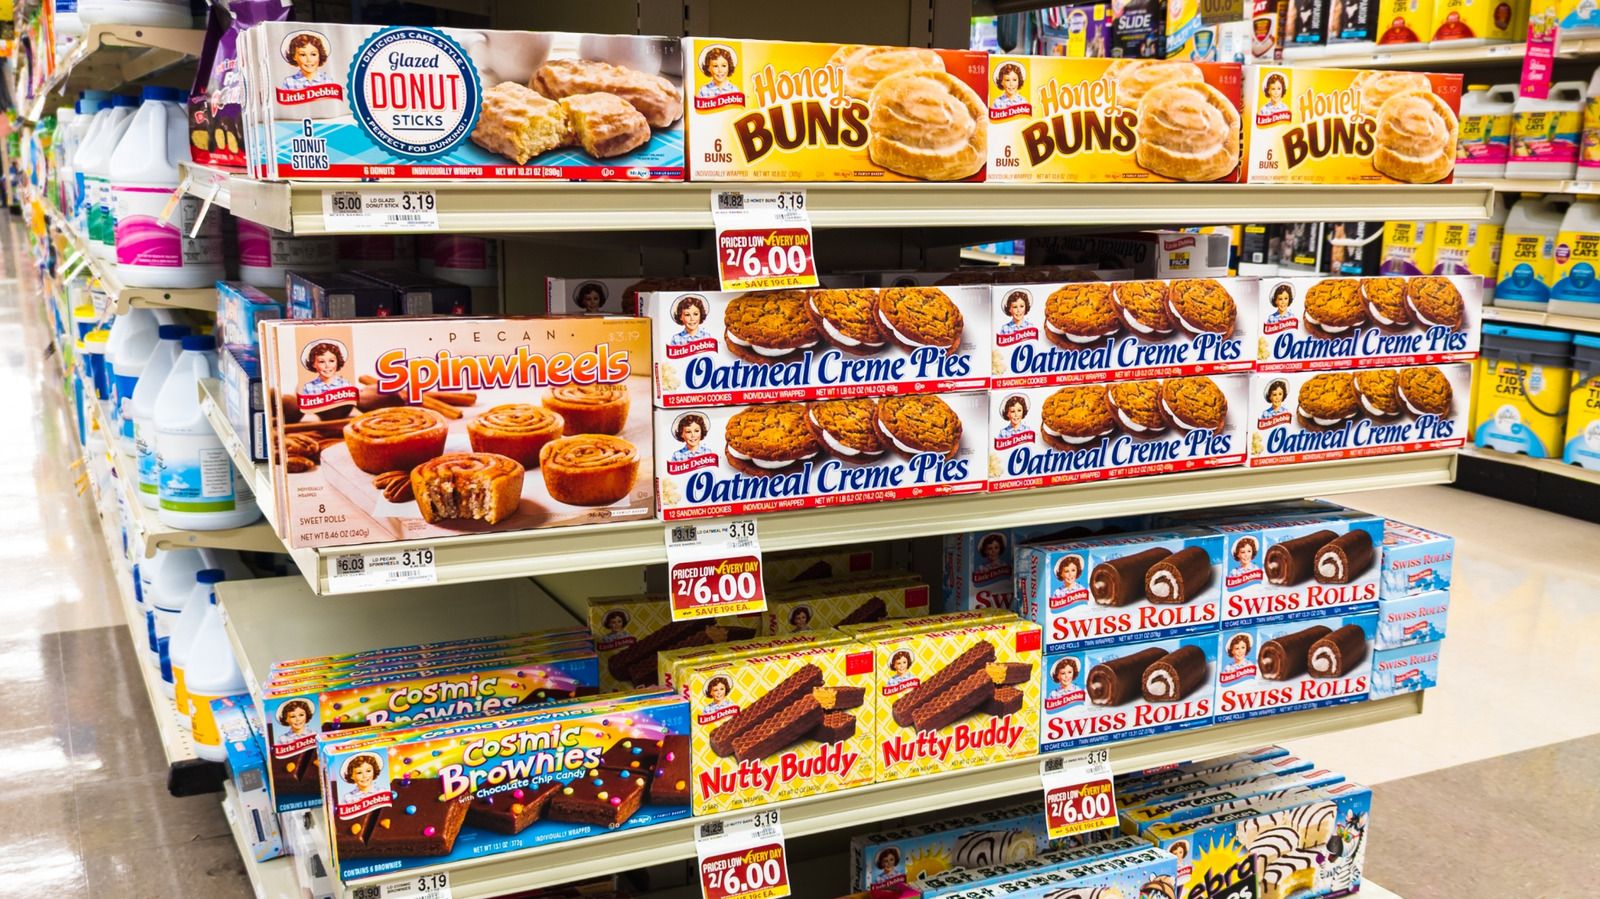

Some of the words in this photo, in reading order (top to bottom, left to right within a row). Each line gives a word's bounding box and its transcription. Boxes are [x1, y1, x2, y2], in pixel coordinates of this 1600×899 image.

[1118, 14, 1151, 30] SLIDE
[364, 32, 406, 62] DELICIOUS
[408, 32, 435, 45] CAKE
[437, 40, 463, 67] STYLE
[389, 52, 439, 71] Glazed
[279, 90, 304, 102] Little
[306, 86, 339, 99] Debbie
[371, 72, 459, 111] DONUT
[754, 65, 846, 107] Honey
[696, 98, 716, 108] Little
[717, 95, 742, 105] Debbie
[1040, 78, 1120, 115] Honey
[1299, 88, 1365, 123] Honey
[304, 119, 312, 137] 6
[393, 115, 442, 126] STICKS
[368, 120, 405, 151] PERFECT
[407, 145, 427, 153] FOR
[429, 119, 467, 151] DUNKING!
[734, 100, 870, 164] BUNS
[1022, 111, 1138, 167] BUNS
[293, 138, 326, 153] DONUT
[714, 139, 722, 152] 6
[1004, 145, 1011, 157] 6
[1282, 117, 1377, 169] BUNS
[292, 154, 328, 170] STICKS
[704, 152, 732, 163] BUNS
[996, 158, 1020, 167] BUNS
[1267, 149, 1272, 160] 6
[364, 167, 368, 175] 6
[370, 166, 395, 175] DONUTS
[412, 167, 452, 175] INDIVIDUALLY
[453, 168, 482, 176] WRAPPED
[495, 168, 505, 176] NET
[507, 168, 516, 176] WT
[518, 168, 532, 176] 10.21
[534, 168, 541, 176] OZ
[1259, 161, 1278, 169] BUNS
[334, 197, 361, 209] $5.00
[402, 195, 434, 210] 3.19
[778, 195, 803, 209] 3.19
[721, 237, 747, 248] PRICED
[749, 236, 764, 246] LOW
[772, 236, 794, 246] EVERY
[795, 235, 808, 245] DAY
[1575, 241, 1599, 250] TIDY
[726, 245, 806, 276] 2/6.00
[1514, 250, 1537, 258] CATS
[1572, 249, 1599, 257] CATS
[745, 280, 768, 288] SAVE
[449, 330, 556, 342] PECAN
[1274, 328, 1359, 359] Oatmeal
[1362, 328, 1423, 355] Creme
[1426, 326, 1467, 351] Pies
[669, 345, 690, 357] Little
[692, 340, 715, 353] Debbie
[1010, 338, 1114, 374] Oatmeal
[1117, 337, 1188, 368] Creme
[1193, 333, 1242, 360] Pies
[378, 344, 631, 404] Spinwheels
[685, 351, 812, 389] Oatmeal
[818, 351, 906, 385] Creme
[909, 346, 970, 378] Pies
[300, 394, 325, 406] Little
[326, 390, 356, 403] Debbie
[676, 395, 706, 403] SANDWICH
[1267, 420, 1352, 454] Oatmeal
[1353, 419, 1413, 446] Creme
[1415, 414, 1454, 439] Pies
[1008, 438, 1107, 476] Oatmeal
[1112, 436, 1180, 466] Creme
[1184, 429, 1231, 456] Pies
[669, 461, 691, 473] Little
[692, 456, 716, 469] Debbie
[686, 462, 810, 503] Oatmeal
[817, 460, 903, 494] Creme
[908, 452, 968, 483] Pies
[319, 504, 325, 513] 8
[300, 515, 324, 525] SWEET
[326, 514, 345, 524] ROLLS
[301, 531, 314, 541] NET
[315, 531, 325, 540] WT
[325, 530, 339, 539] 8.46
[340, 529, 349, 538] OZ
[349, 528, 369, 539] (240g)
[730, 523, 754, 537] 3.19
[338, 559, 364, 570] $6.03
[403, 551, 432, 565] 3.19
[1392, 558, 1421, 571] SWISS
[1423, 552, 1451, 565] ROLLS
[673, 568, 698, 579] PRICED
[700, 566, 715, 576] LOW
[722, 563, 743, 574] EVERY
[745, 562, 758, 572] DAY
[678, 572, 756, 603] 2/6.00
[1050, 598, 1068, 608] Little
[1068, 592, 1088, 604] Debbie
[1228, 592, 1300, 618] SWISS
[1306, 583, 1376, 608] ROLLS
[696, 607, 718, 616] SAVE
[1387, 612, 1417, 624] SWISS
[1419, 604, 1446, 616] ROLLS
[1053, 616, 1130, 641] SWISS
[1139, 603, 1216, 630] ROLLS
[1378, 659, 1408, 671] SWISS
[1410, 653, 1438, 665] ROLLS
[388, 675, 499, 713] Cosmic
[883, 685, 902, 695] Little
[902, 680, 920, 691] Debbie
[1221, 689, 1292, 712] SWISS
[1300, 676, 1367, 701] ROLLS
[698, 713, 720, 724] Little
[721, 707, 739, 721] Debbie
[1048, 714, 1126, 740] SWISS
[1134, 699, 1209, 726] ROLLS
[462, 724, 584, 766] Cosmic
[882, 730, 952, 770] Nutty
[954, 714, 1025, 752] Buddy
[1088, 751, 1107, 764] 3.19
[439, 746, 603, 800] Brownies
[698, 759, 779, 800] Nutty
[781, 741, 858, 783] Buddy
[459, 794, 474, 804] with
[477, 781, 529, 798] Chocolate
[532, 776, 554, 787] Chip
[556, 769, 585, 783] Candy
[339, 803, 364, 818] Little
[366, 793, 392, 812] Debbie
[1051, 793, 1110, 823] 2/6.00
[755, 812, 777, 827] 3.19
[344, 867, 369, 877] CONTAINS
[375, 861, 402, 871] BROWNIES
[708, 859, 780, 894] 2/6.00
[418, 875, 446, 891] 3.19
